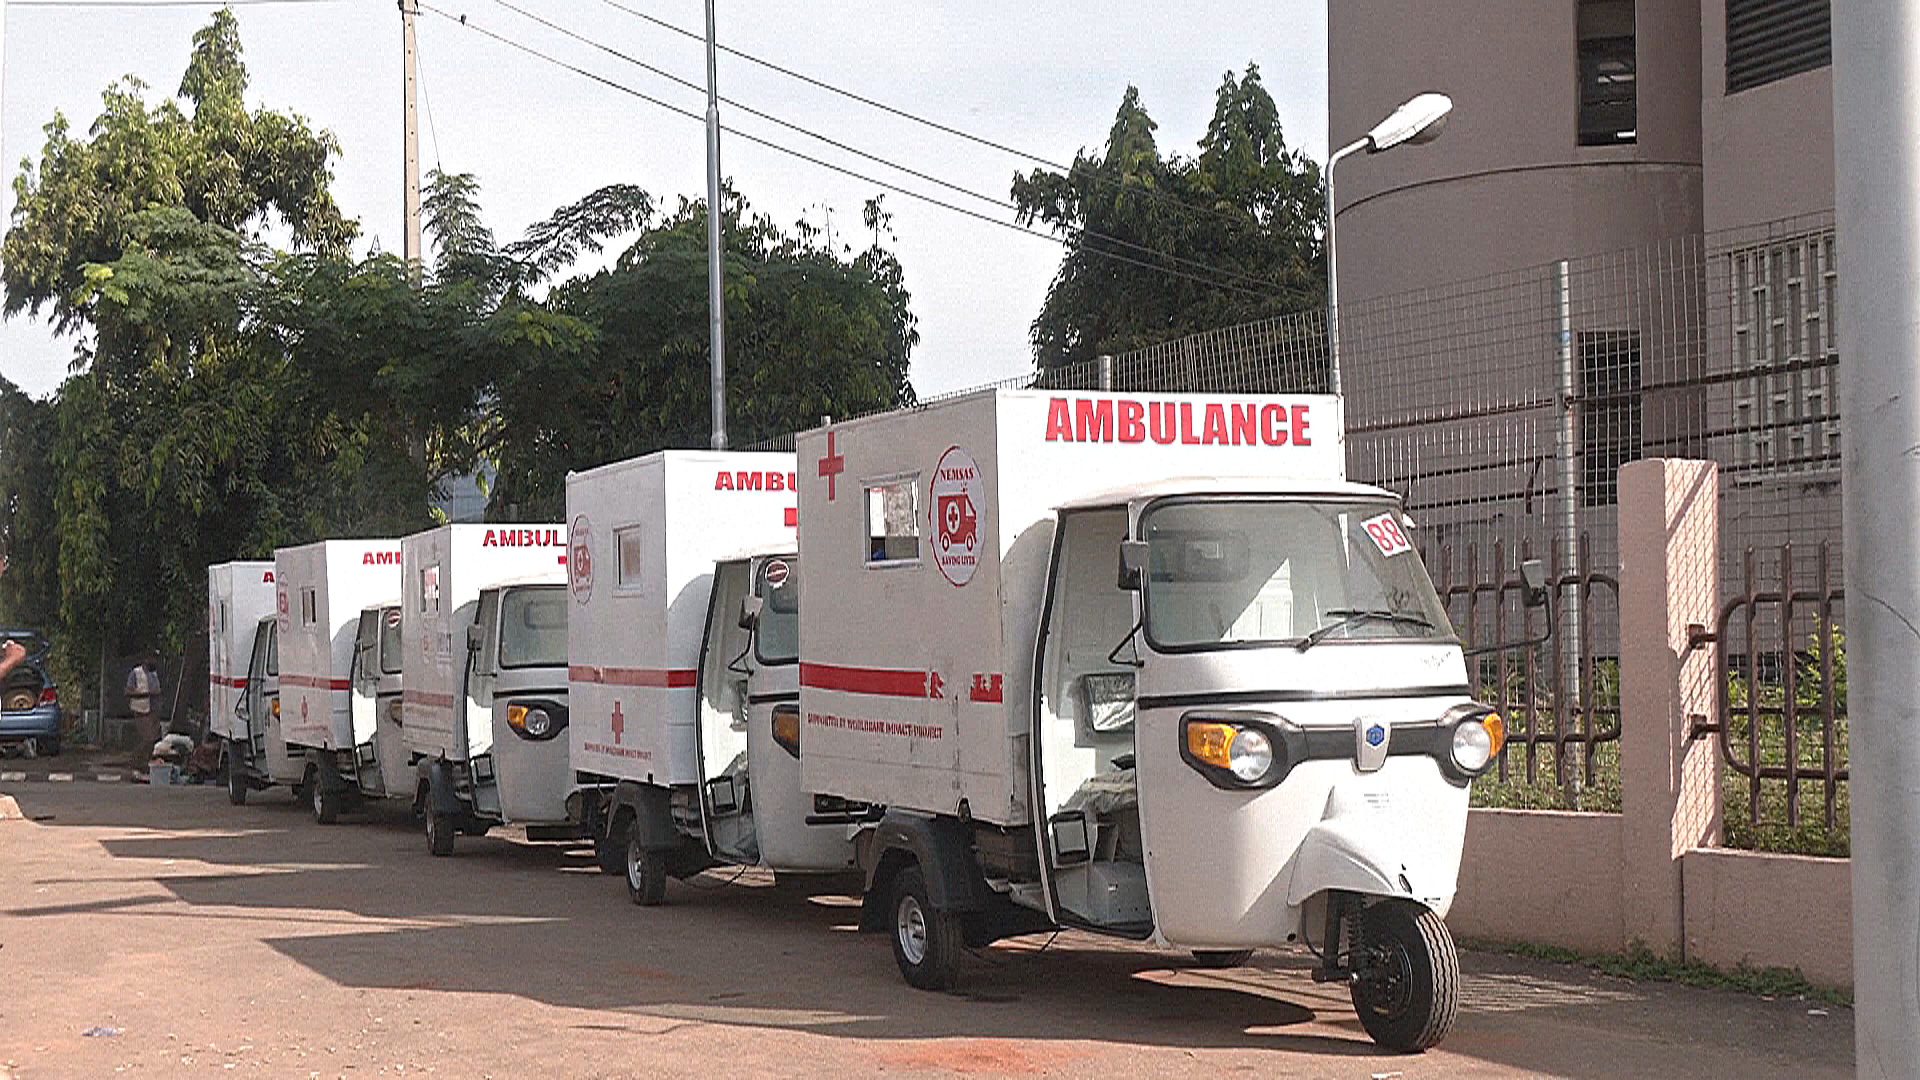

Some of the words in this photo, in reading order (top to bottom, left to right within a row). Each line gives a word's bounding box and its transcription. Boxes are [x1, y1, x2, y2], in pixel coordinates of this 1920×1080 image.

[1045, 397, 1312, 447] AMBULANCE
[940, 467, 974, 481] NEMSAS
[1367, 517, 1406, 552] 88
